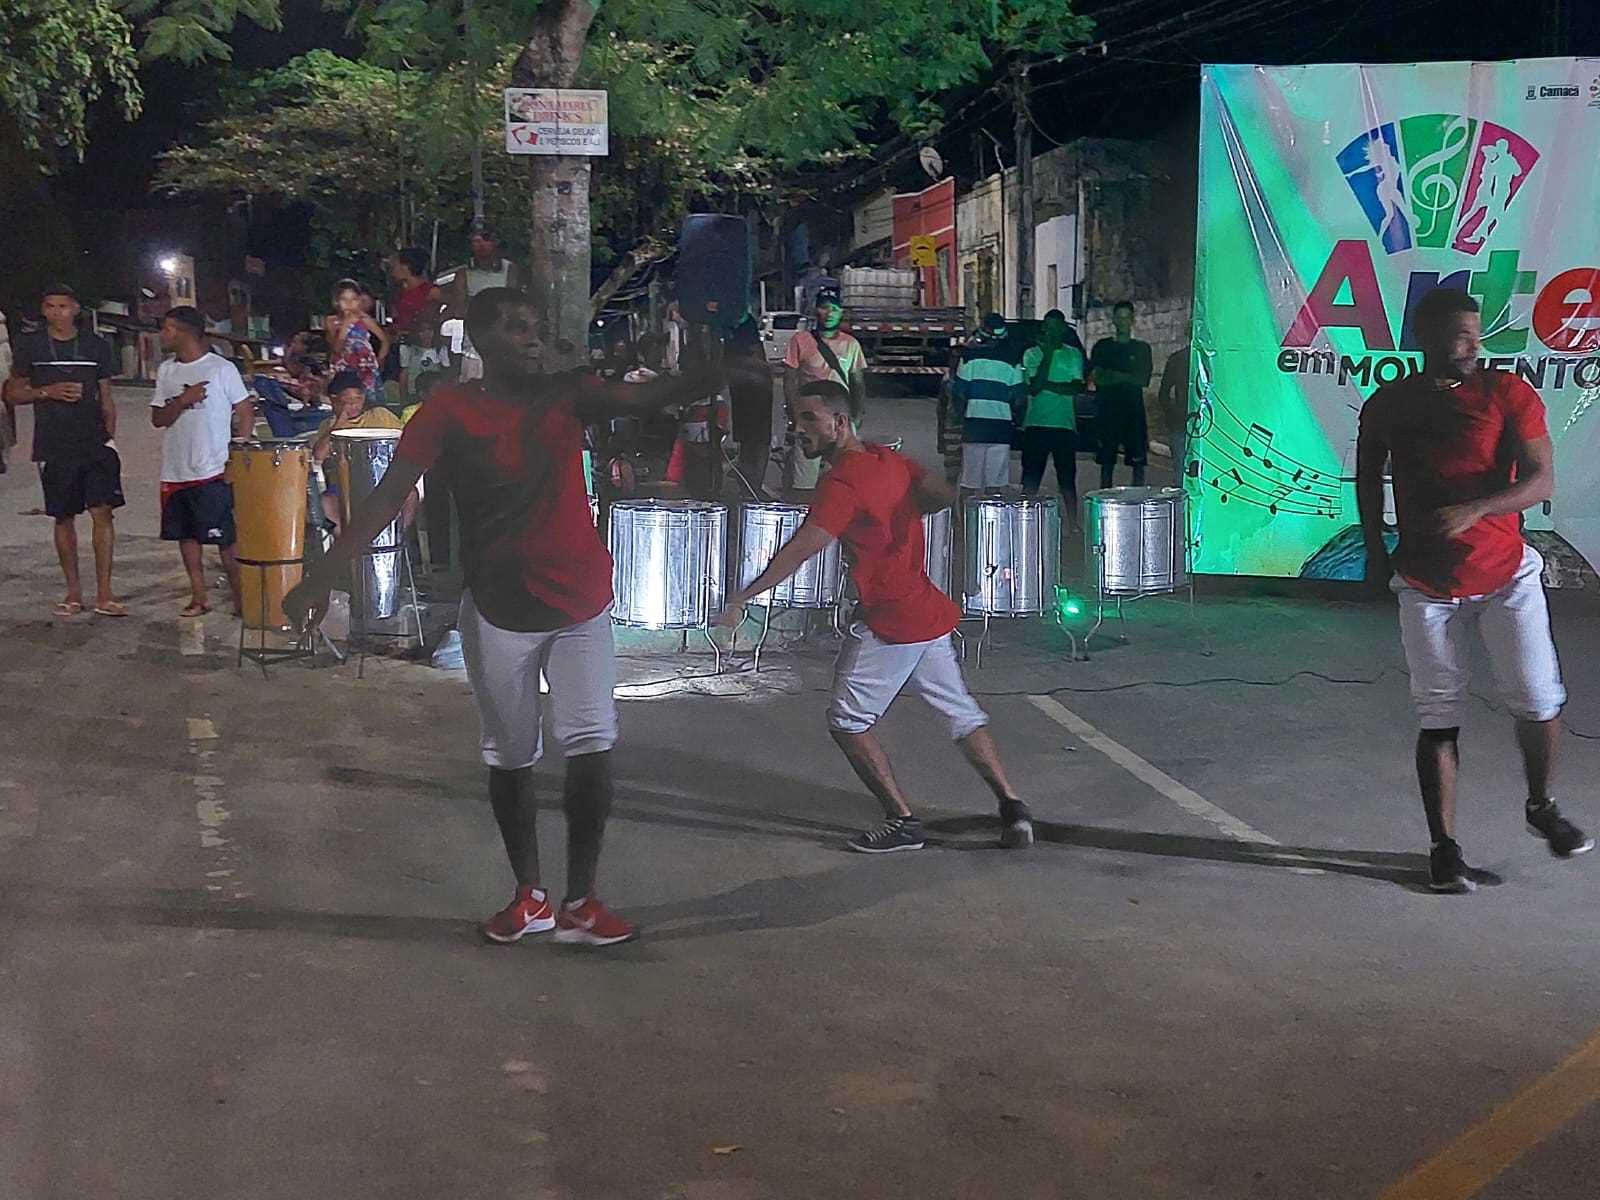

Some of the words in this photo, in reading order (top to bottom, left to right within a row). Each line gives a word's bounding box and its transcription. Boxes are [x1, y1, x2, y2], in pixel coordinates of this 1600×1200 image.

[1280, 239, 1600, 355] Arte
[1277, 349, 1336, 374] em
[1338, 355, 1600, 389] MOENTO
